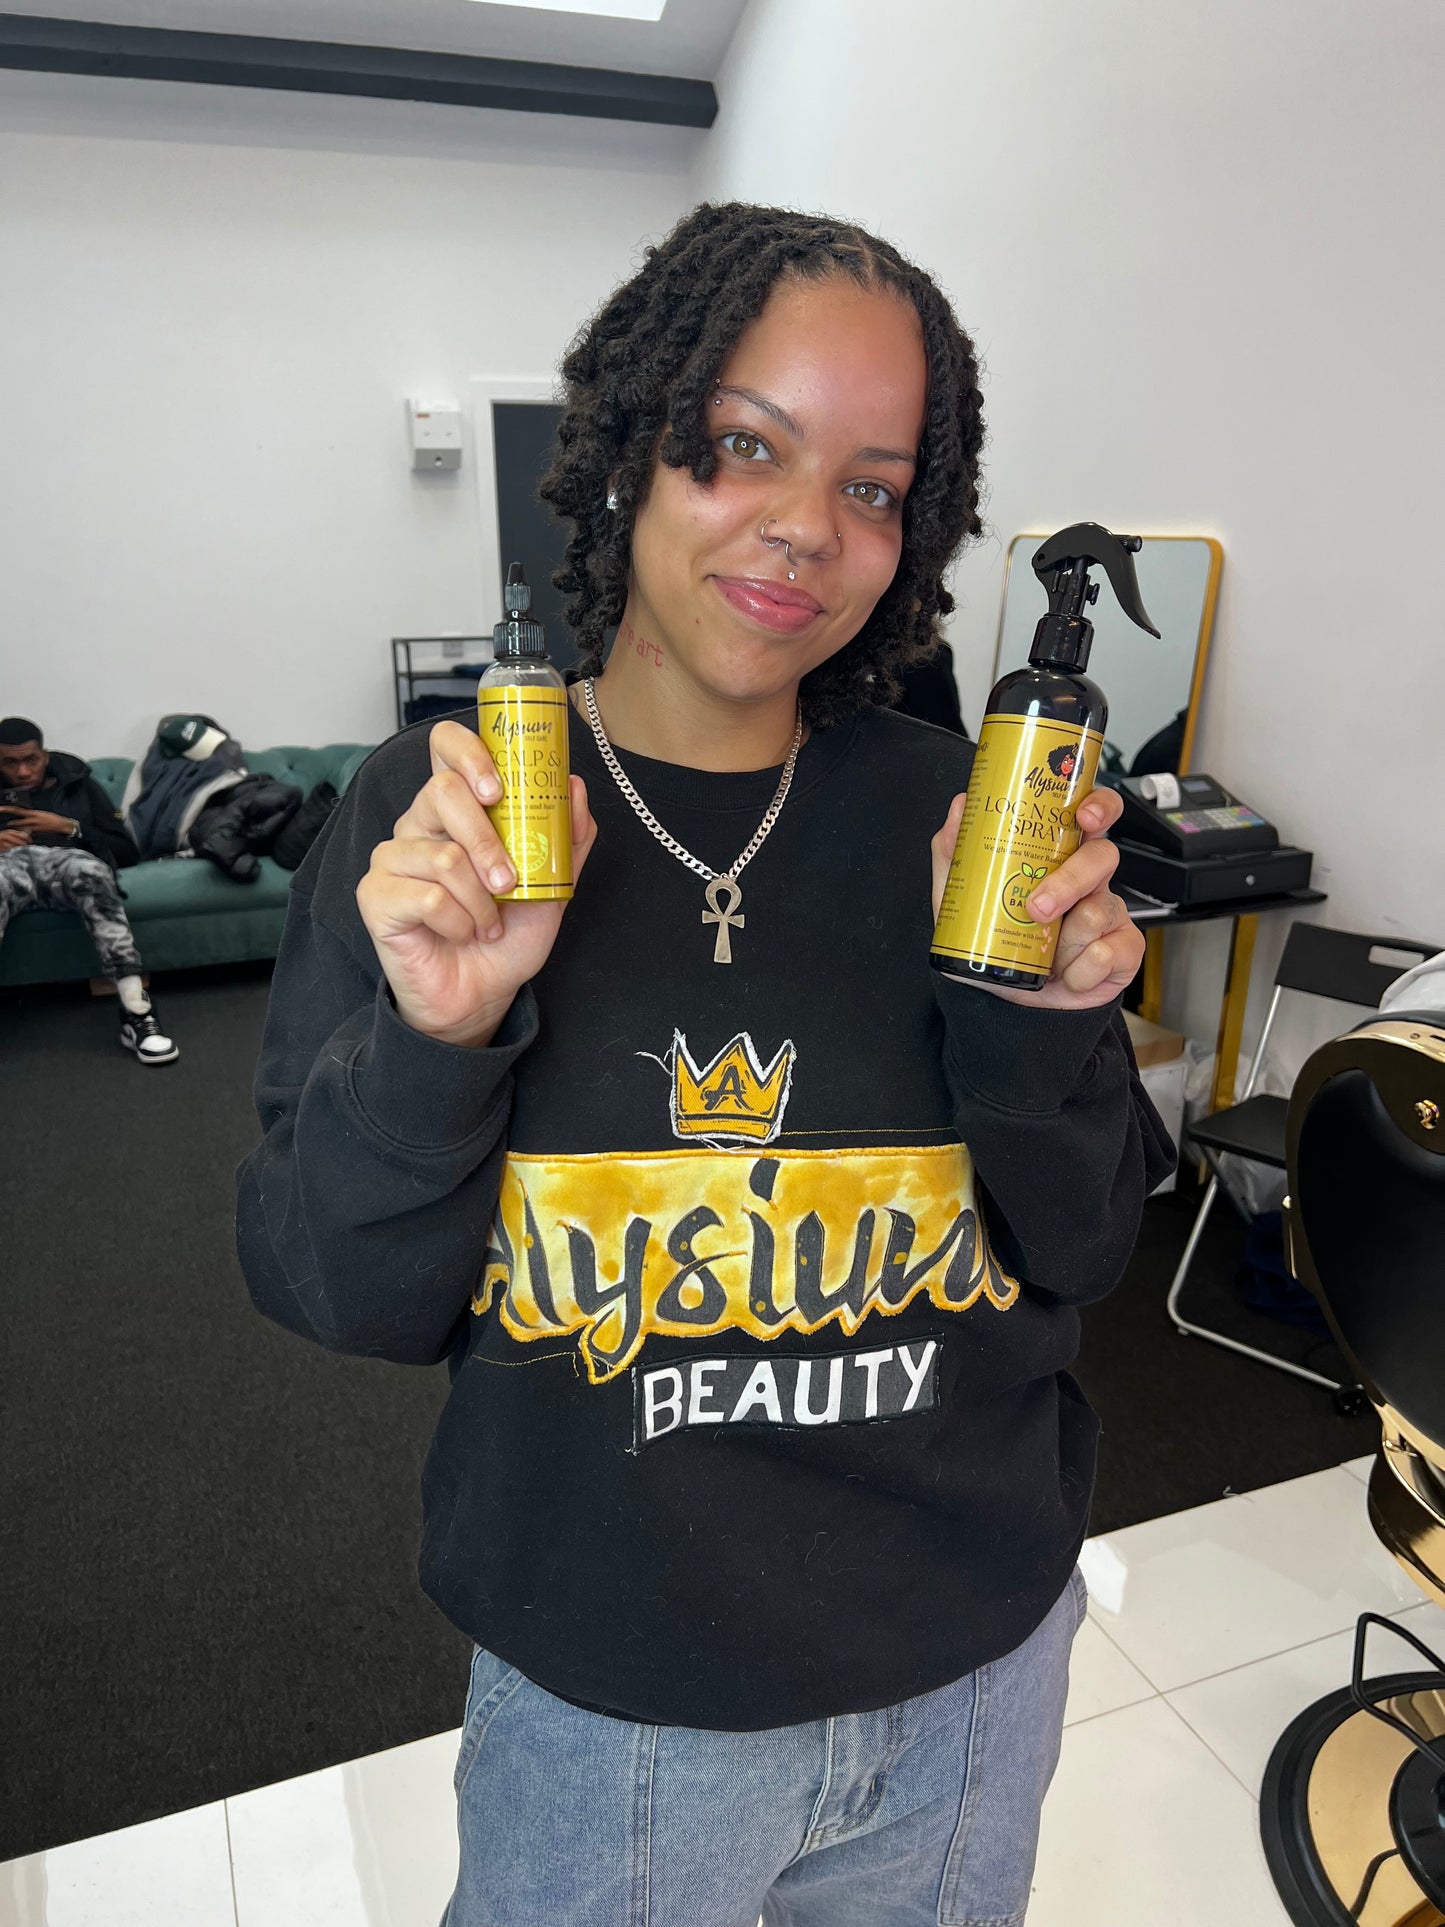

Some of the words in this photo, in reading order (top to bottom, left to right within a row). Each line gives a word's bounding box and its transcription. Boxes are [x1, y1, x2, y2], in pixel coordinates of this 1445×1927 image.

[637, 638, 664, 666] art
[491, 711, 552, 745] Alysium
[548, 750, 561, 767] &
[503, 771, 529, 787] AIR
[534, 771, 562, 788] OIL
[985, 796, 1027, 817] LOC
[1030, 803, 1046, 820] N
[1048, 807, 1080, 830] SCA
[1008, 818, 1066, 842] SPRAY
[1024, 850, 1044, 860] Water
[1012, 885, 1031, 899] PLA
[993, 927, 1021, 938] andmade
[1023, 932, 1034, 940] with
[704, 1065, 754, 1111] A
[643, 1340, 937, 1440] BEAUTY
